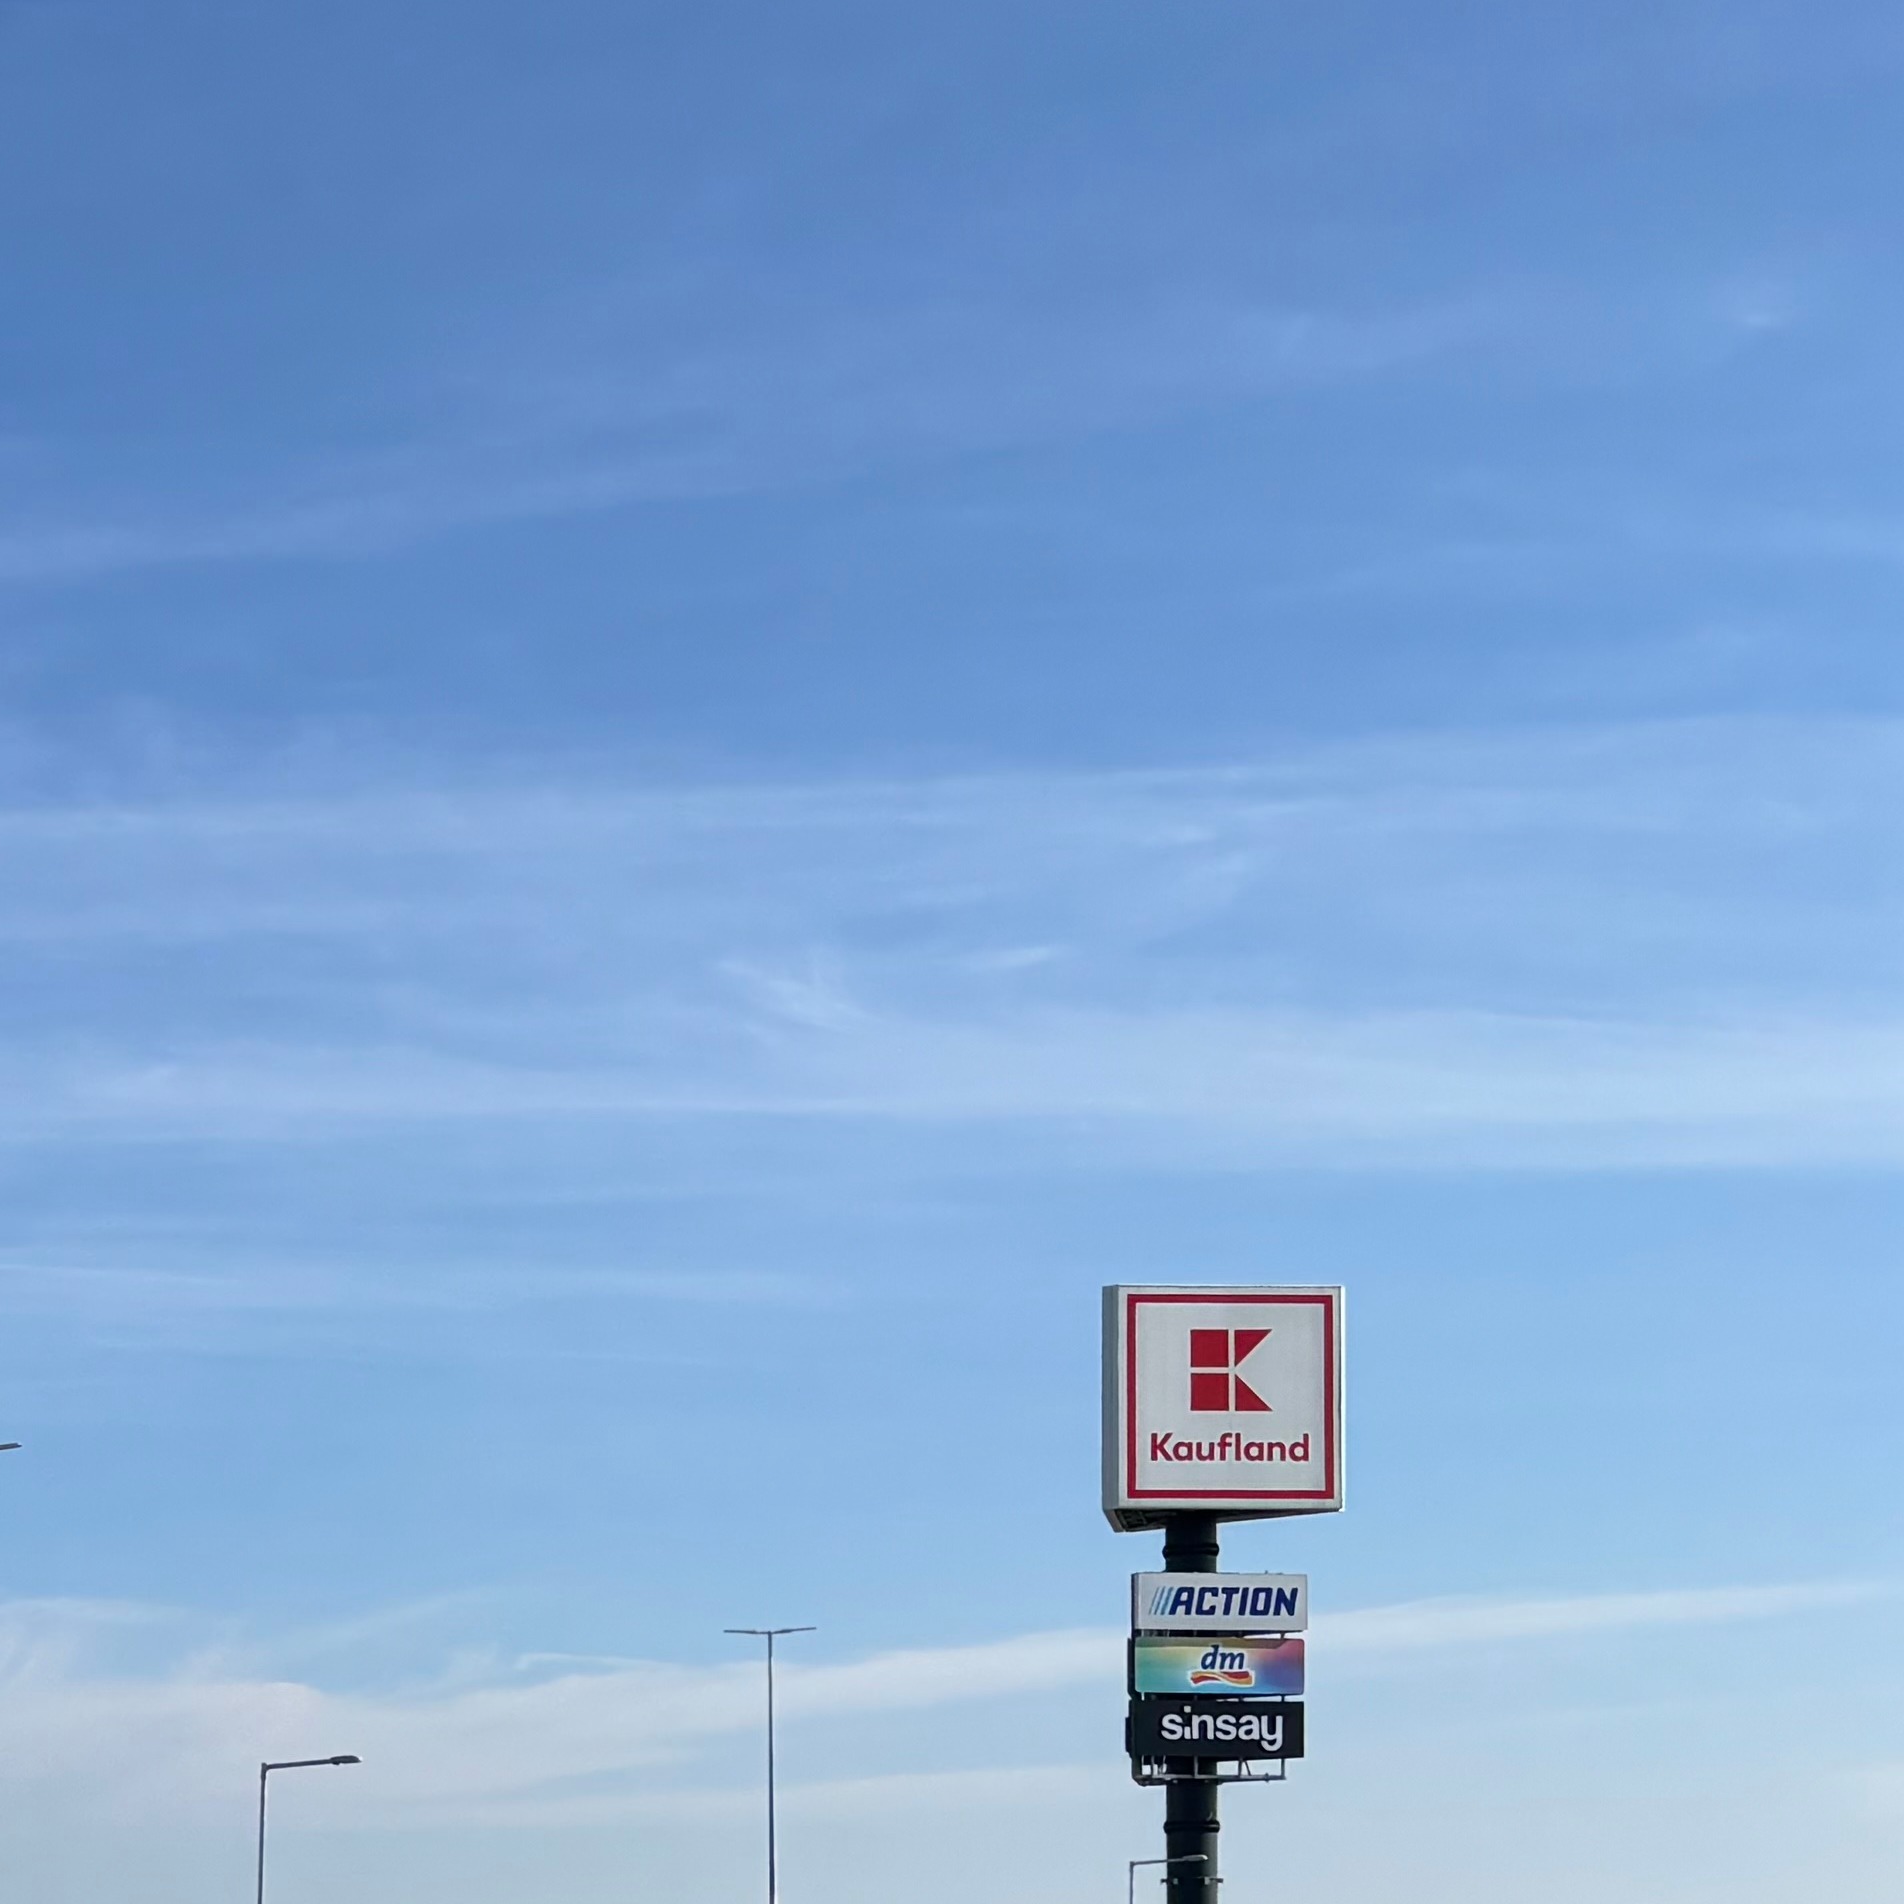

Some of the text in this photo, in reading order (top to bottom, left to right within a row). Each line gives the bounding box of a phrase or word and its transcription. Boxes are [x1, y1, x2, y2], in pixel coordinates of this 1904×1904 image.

[1150, 1432, 1310, 1462] Kaufland
[1168, 1587, 1298, 1616] ACTION
[1200, 1645, 1245, 1670] dm
[1161, 1706, 1283, 1751] sinsay
